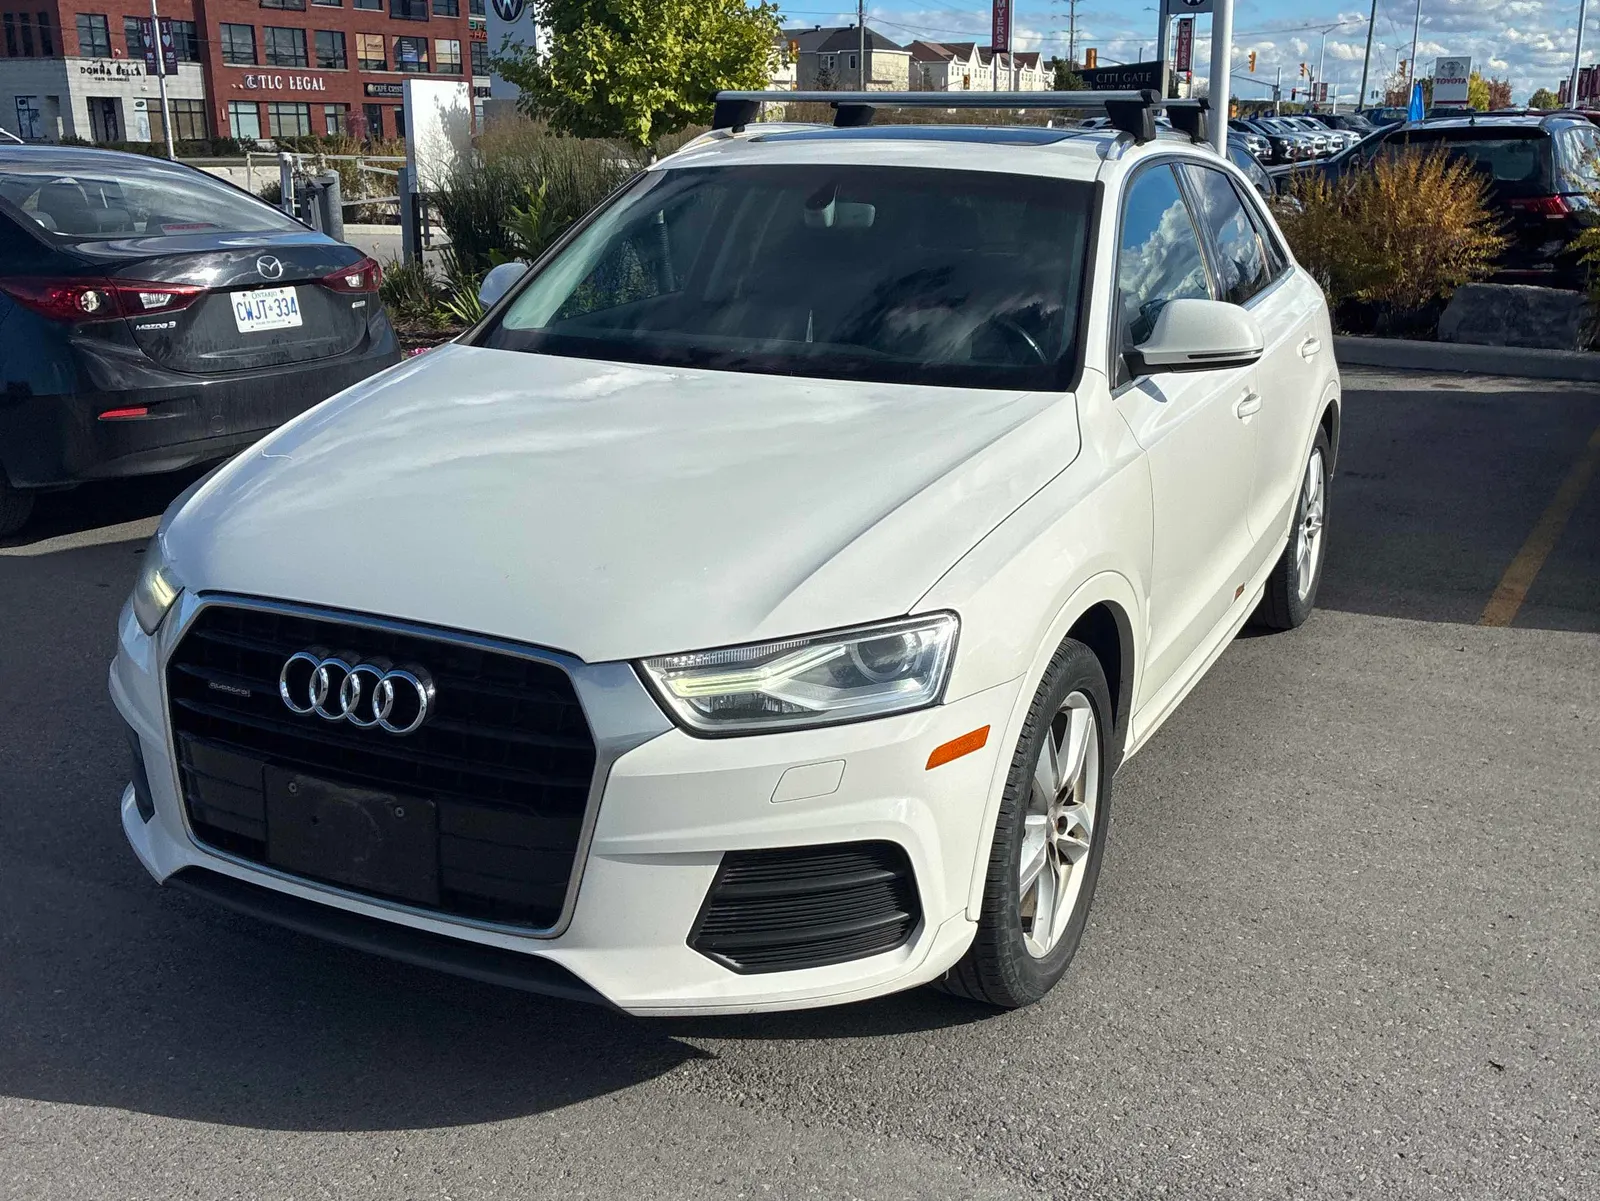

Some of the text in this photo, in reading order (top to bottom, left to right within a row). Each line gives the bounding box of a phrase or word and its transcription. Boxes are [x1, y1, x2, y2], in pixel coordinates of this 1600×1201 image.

[996, 0, 1005, 43] MYERS
[258, 75, 326, 91] TLC LEGAL
[1096, 72, 1152, 83] CITI GATE
[251, 291, 277, 299] ONTARIO
